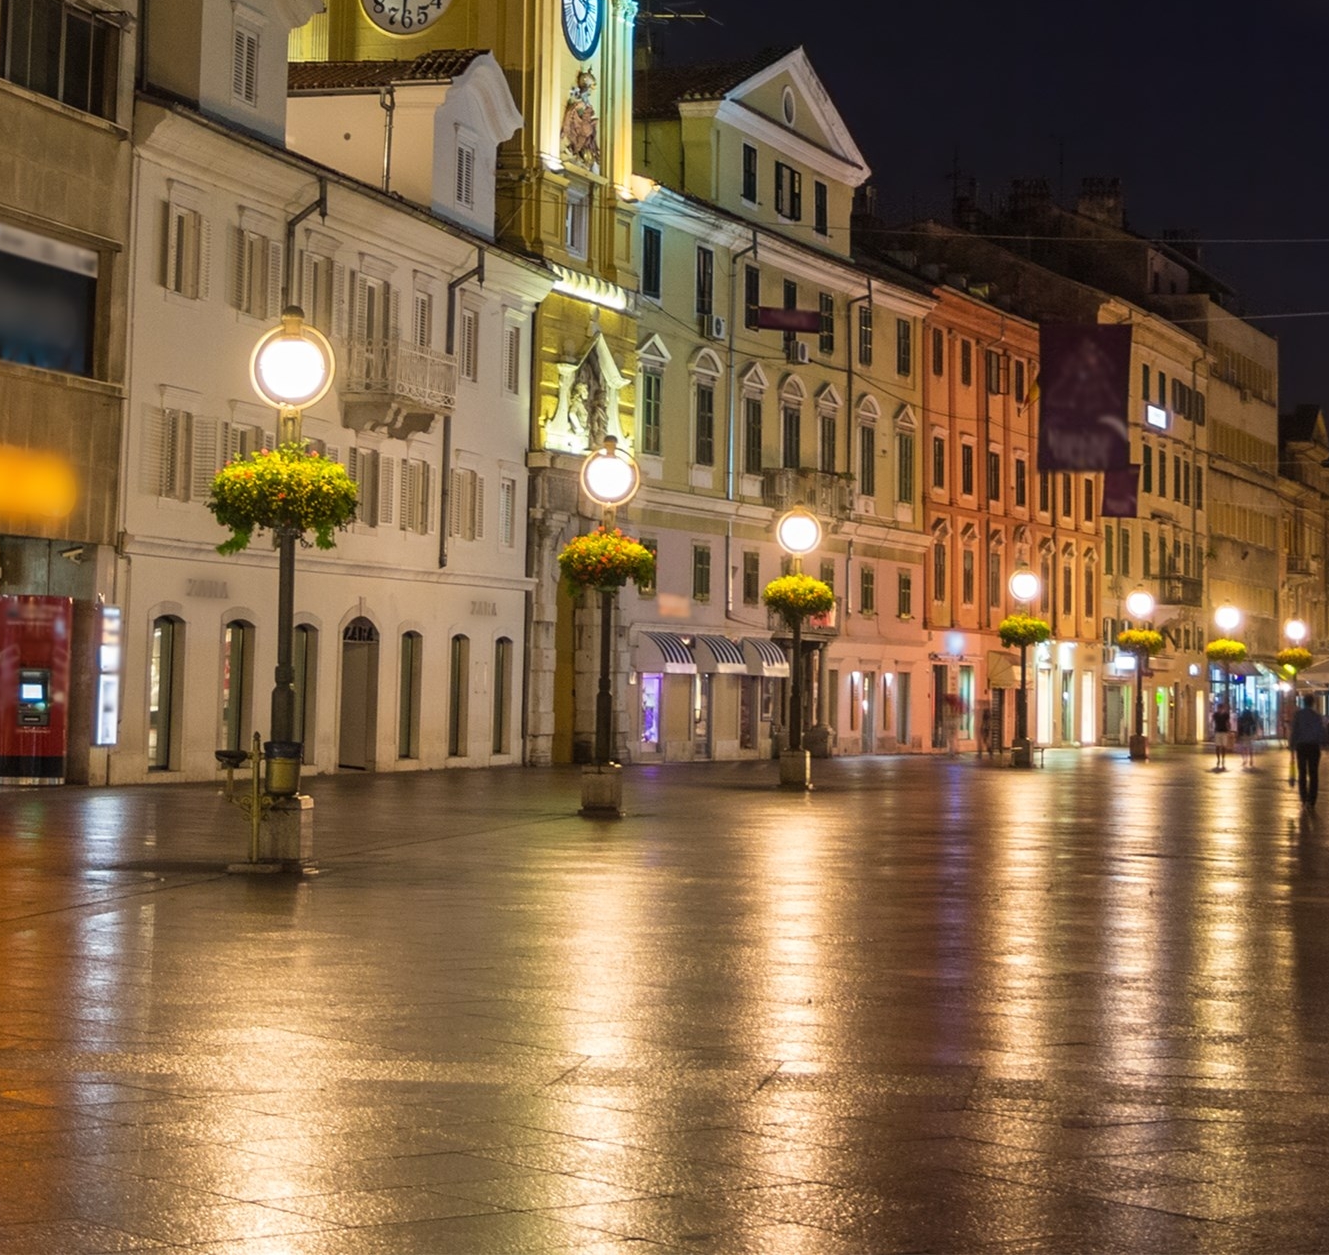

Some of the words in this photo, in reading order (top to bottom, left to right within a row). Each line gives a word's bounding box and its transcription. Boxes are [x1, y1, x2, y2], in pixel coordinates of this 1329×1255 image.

[388, 7, 400, 25] 7
[401, 9, 413, 29] 6
[417, 5, 430, 25] 5
[470, 601, 498, 617] ZARA
[346, 624, 378, 641] ZARA
